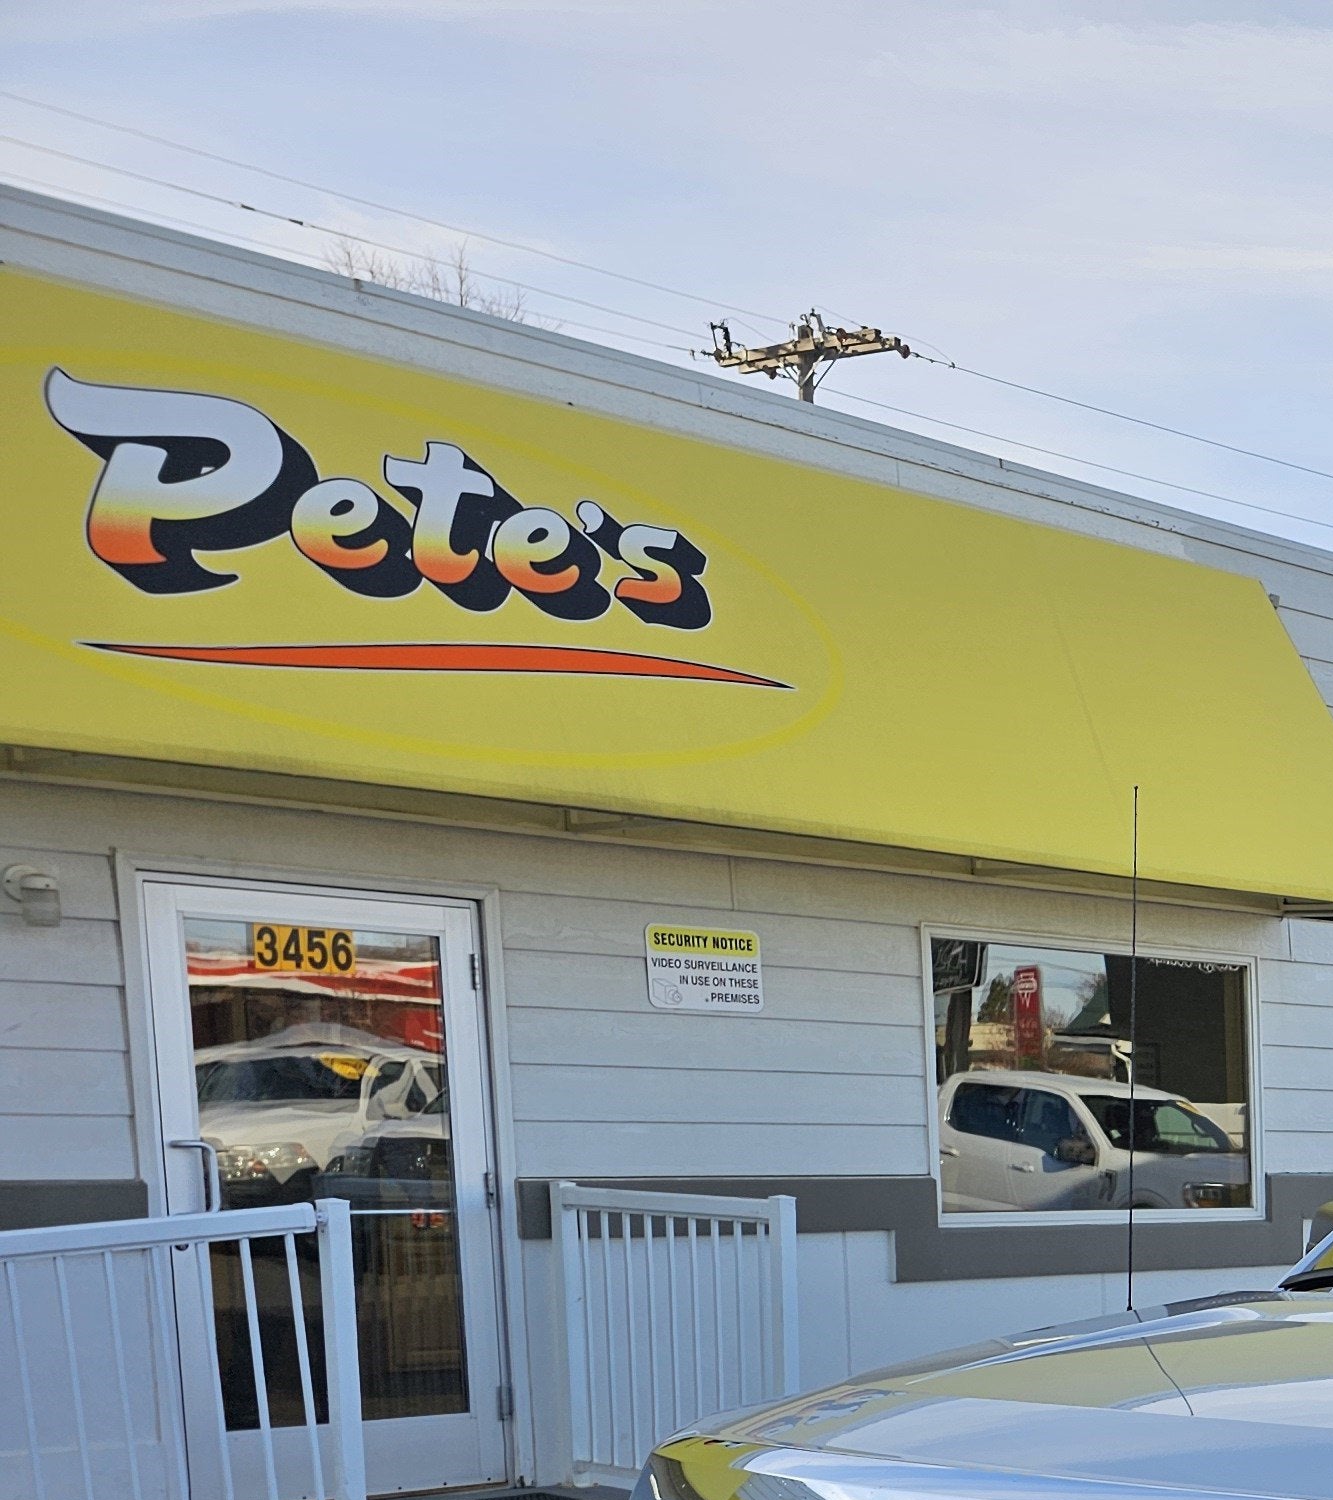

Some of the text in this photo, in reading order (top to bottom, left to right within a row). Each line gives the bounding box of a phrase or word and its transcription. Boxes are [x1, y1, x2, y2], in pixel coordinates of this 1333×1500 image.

[44, 366, 712, 630] Pete's
[256, 925, 353, 972] 3456
[653, 931, 754, 952] SECURITY NOTICE
[651, 957, 758, 974] VIDEO SURVEILLANCE
[679, 974, 759, 990] IN USE ON THESE
[710, 992, 760, 1005] PREMISES
